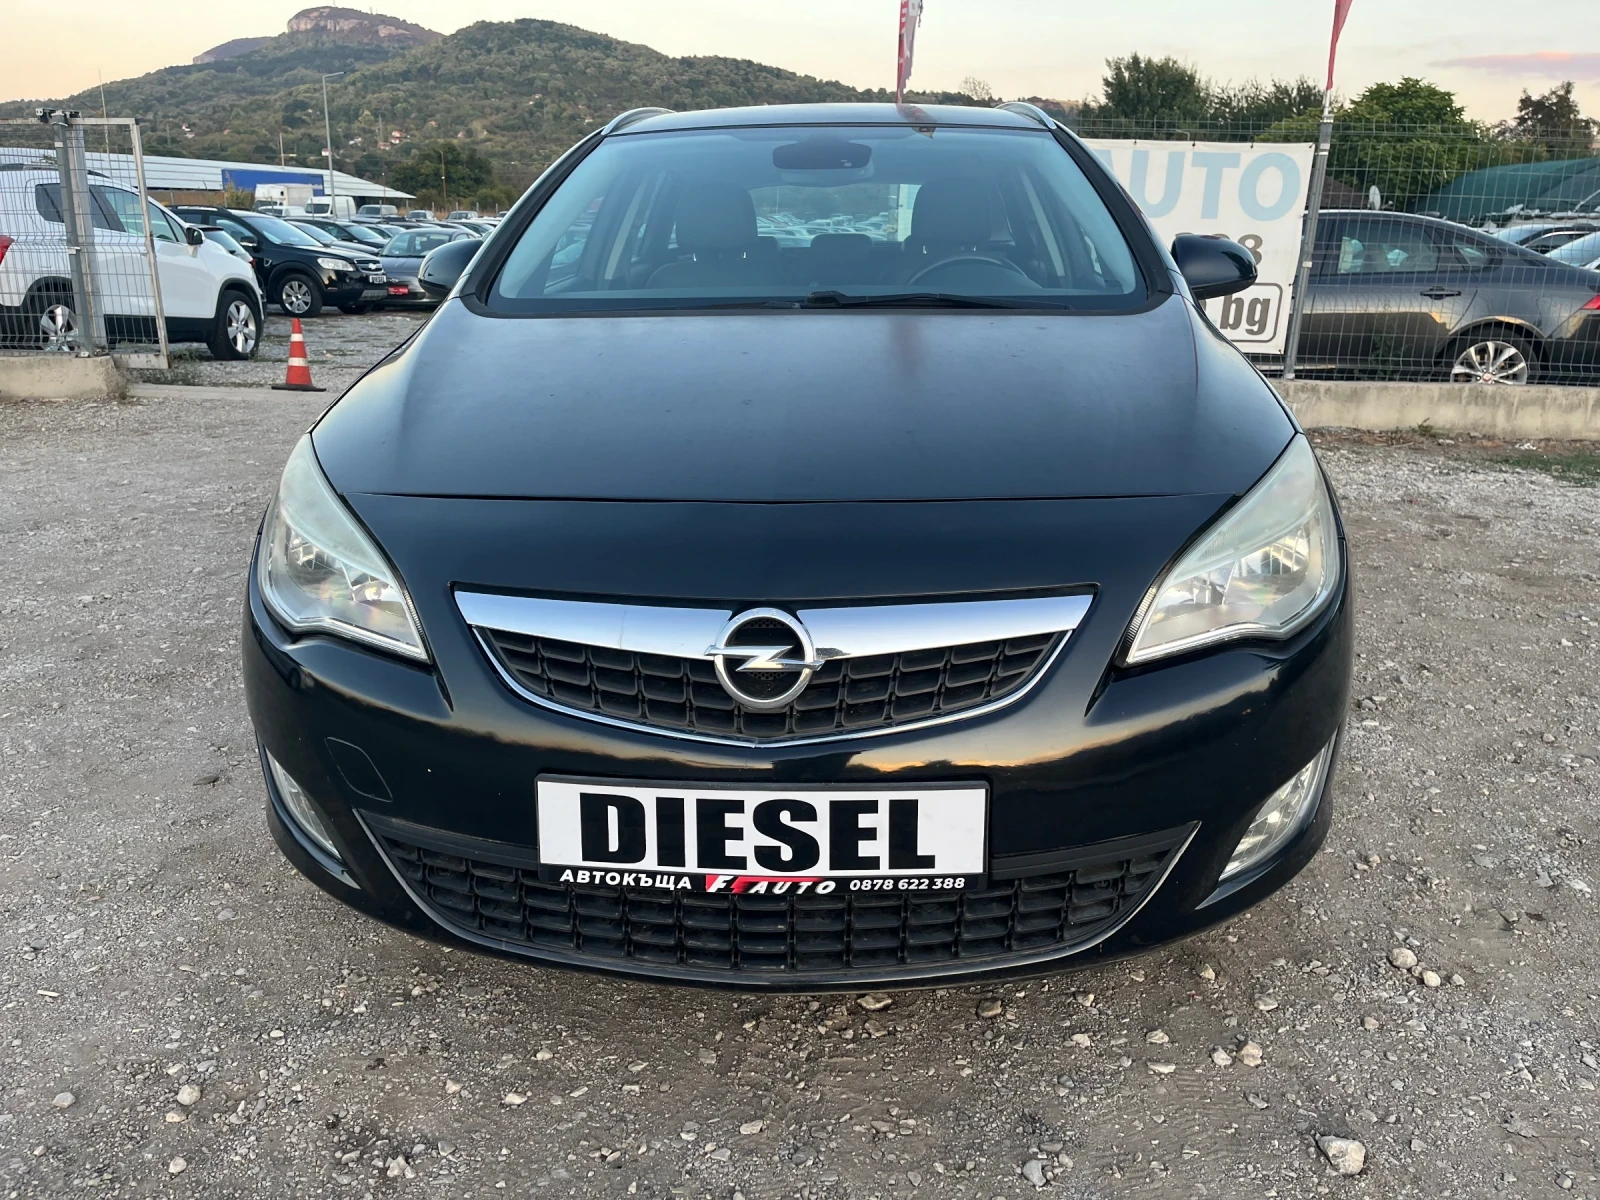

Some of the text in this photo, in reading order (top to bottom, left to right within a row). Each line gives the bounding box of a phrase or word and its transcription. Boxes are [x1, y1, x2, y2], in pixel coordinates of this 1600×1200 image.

[1094, 149, 1301, 222] UTO
[579, 792, 936, 873] DIESEL
[559, 868, 692, 891] АВТОКЪЩА
[748, 880, 837, 895] AUTO
[849, 879, 894, 891] 0878
[898, 878, 930, 890] 622
[931, 877, 966, 889] 388
